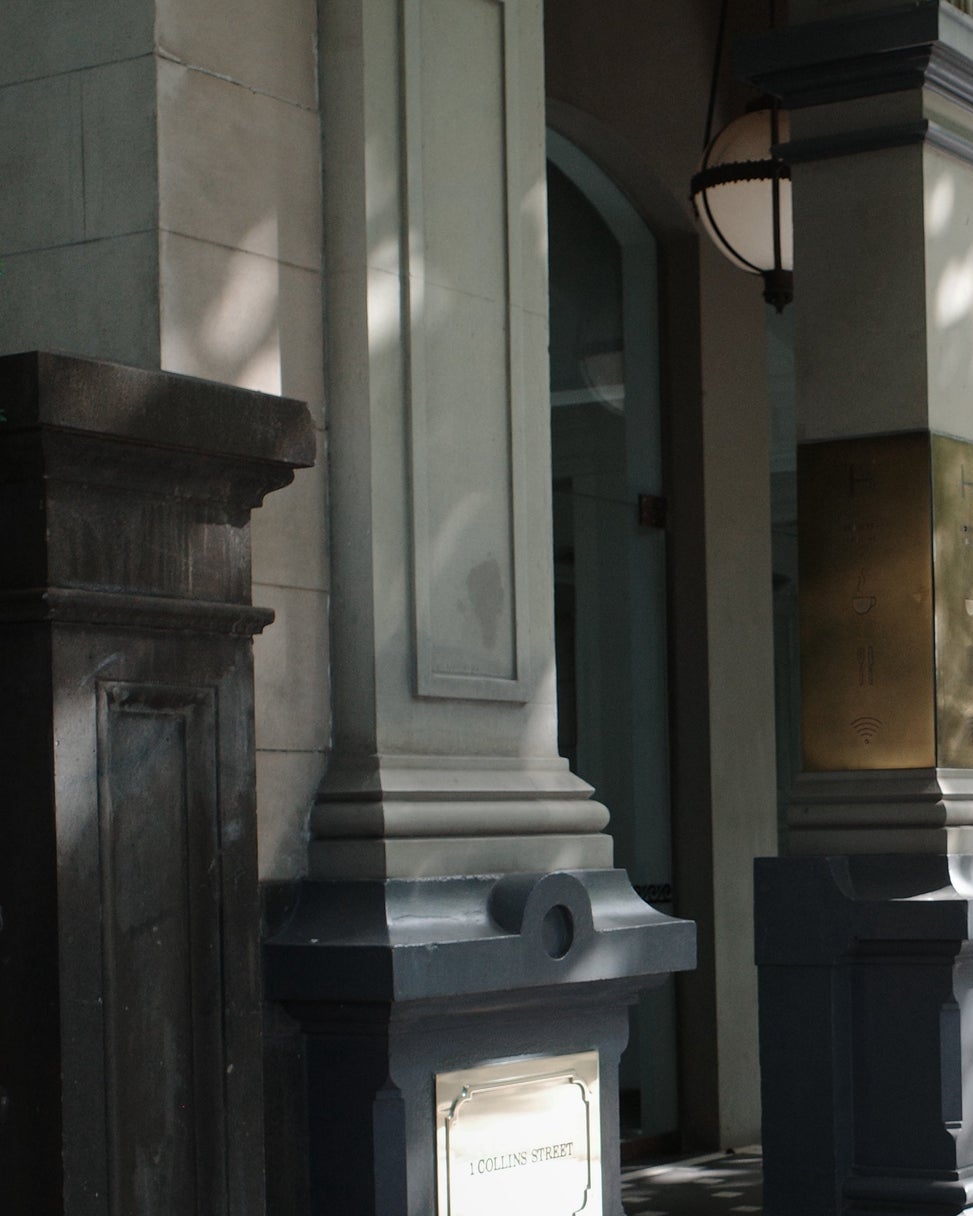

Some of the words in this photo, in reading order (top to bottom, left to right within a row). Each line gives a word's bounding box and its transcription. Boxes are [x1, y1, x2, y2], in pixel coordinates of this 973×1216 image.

[470, 1162, 475, 1175] 1
[477, 1151, 527, 1174] COLLINS
[531, 1142, 573, 1163] STREET
